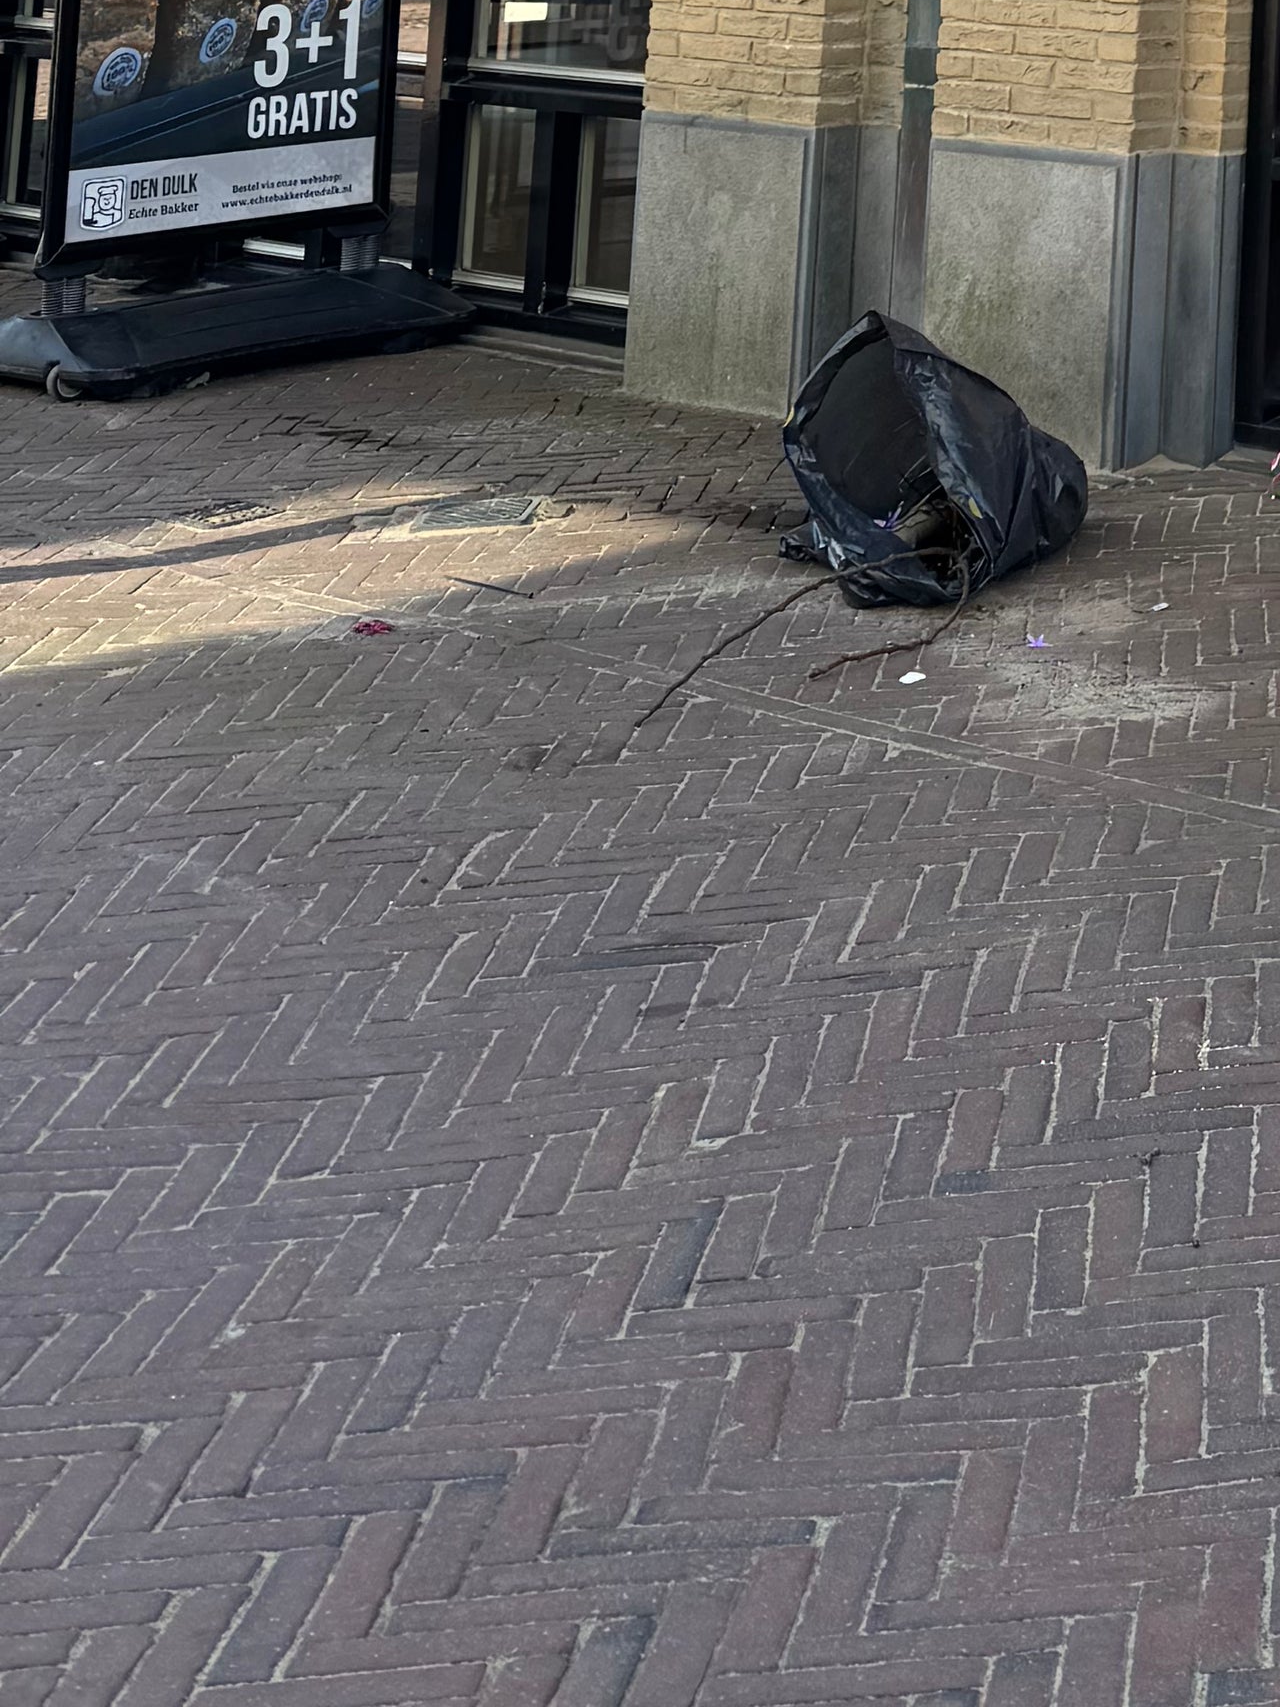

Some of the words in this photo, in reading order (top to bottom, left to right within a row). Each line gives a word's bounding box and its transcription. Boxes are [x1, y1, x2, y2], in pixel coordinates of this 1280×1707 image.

[247, 87, 359, 140] GRATIS
[129, 177, 158, 201] DEN
[162, 172, 199, 196] DULK
[128, 204, 158, 220] Echte
[160, 201, 200, 216] Bakker
